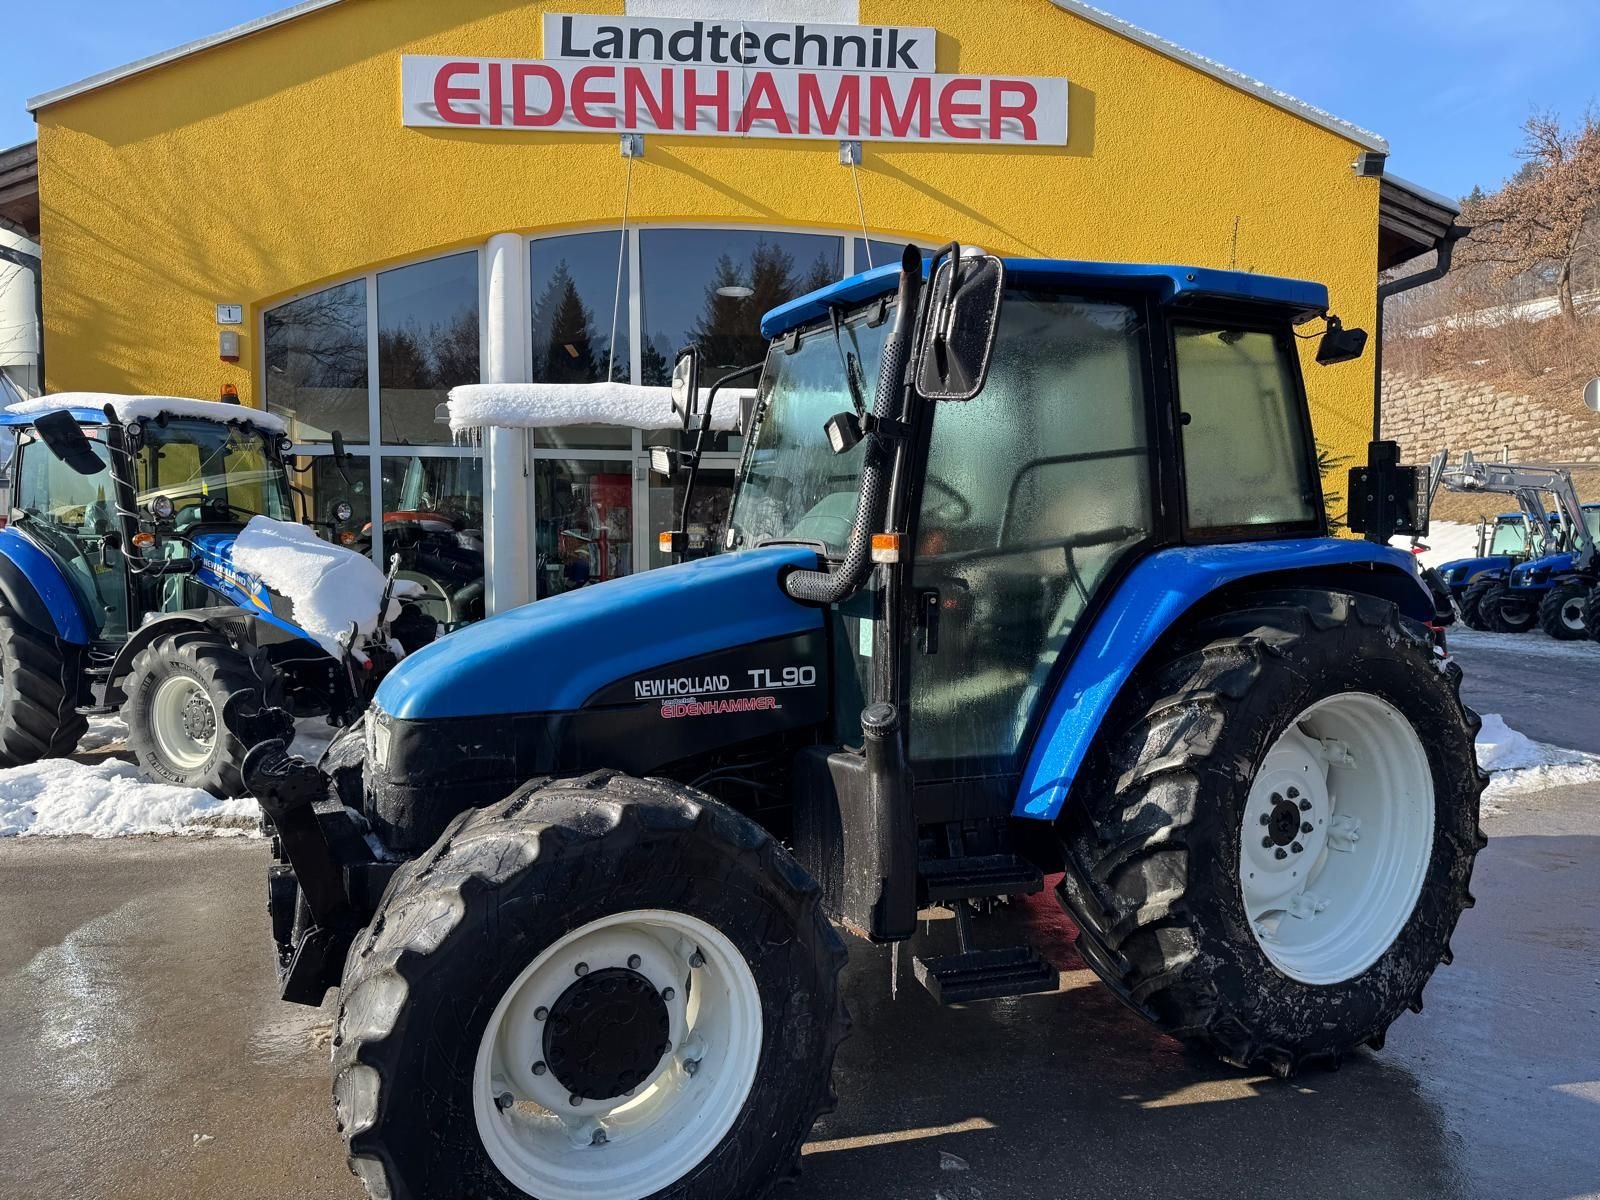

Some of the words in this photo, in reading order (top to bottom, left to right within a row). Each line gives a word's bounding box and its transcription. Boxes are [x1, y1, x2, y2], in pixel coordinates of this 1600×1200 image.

[560, 15, 919, 70] Landtechnik
[433, 61, 1038, 141] EIDENHAMMER
[203, 558, 216, 570] NEW
[217, 564, 246, 586] HOLLAND
[635, 678, 666, 697] NEW
[667, 675, 729, 694] HOLLAND
[748, 666, 816, 687] TL90
[660, 698, 776, 718] EIDENHAMMER
